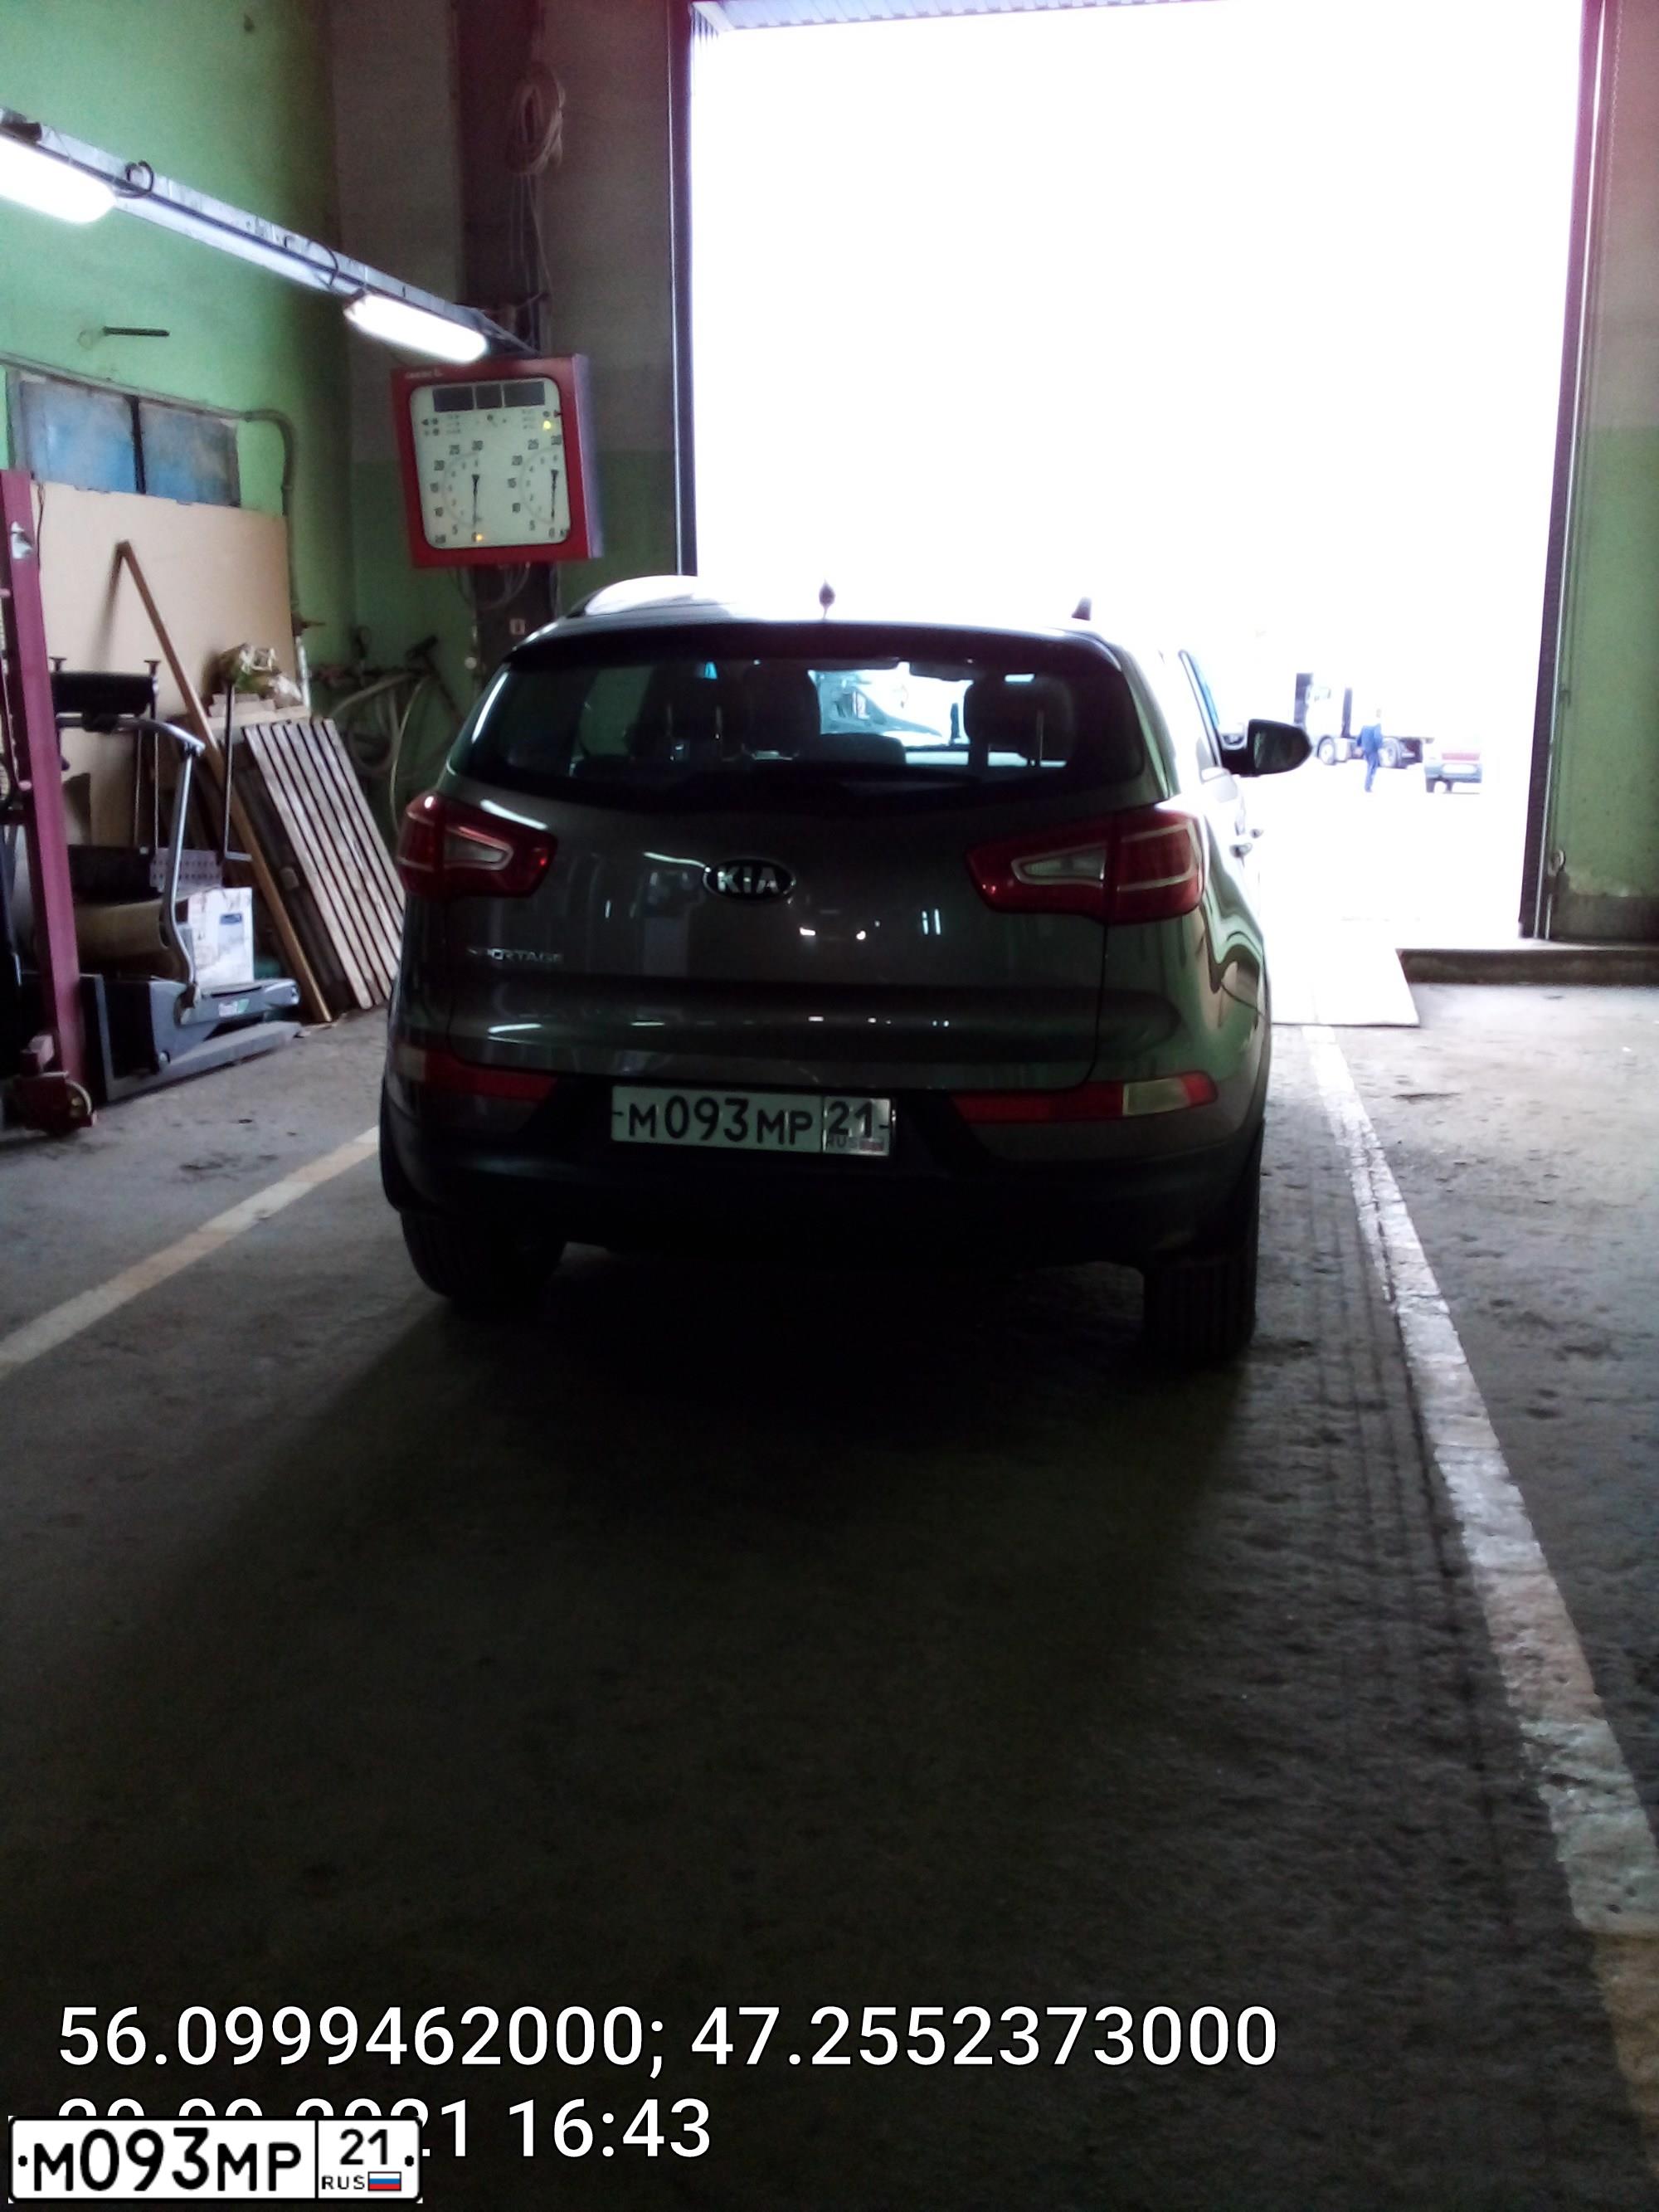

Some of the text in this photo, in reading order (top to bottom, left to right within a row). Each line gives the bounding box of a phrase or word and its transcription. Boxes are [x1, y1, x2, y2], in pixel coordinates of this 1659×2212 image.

[717, 865, 780, 894] KIA
[629, 1095, 873, 1146] М093МР 21
